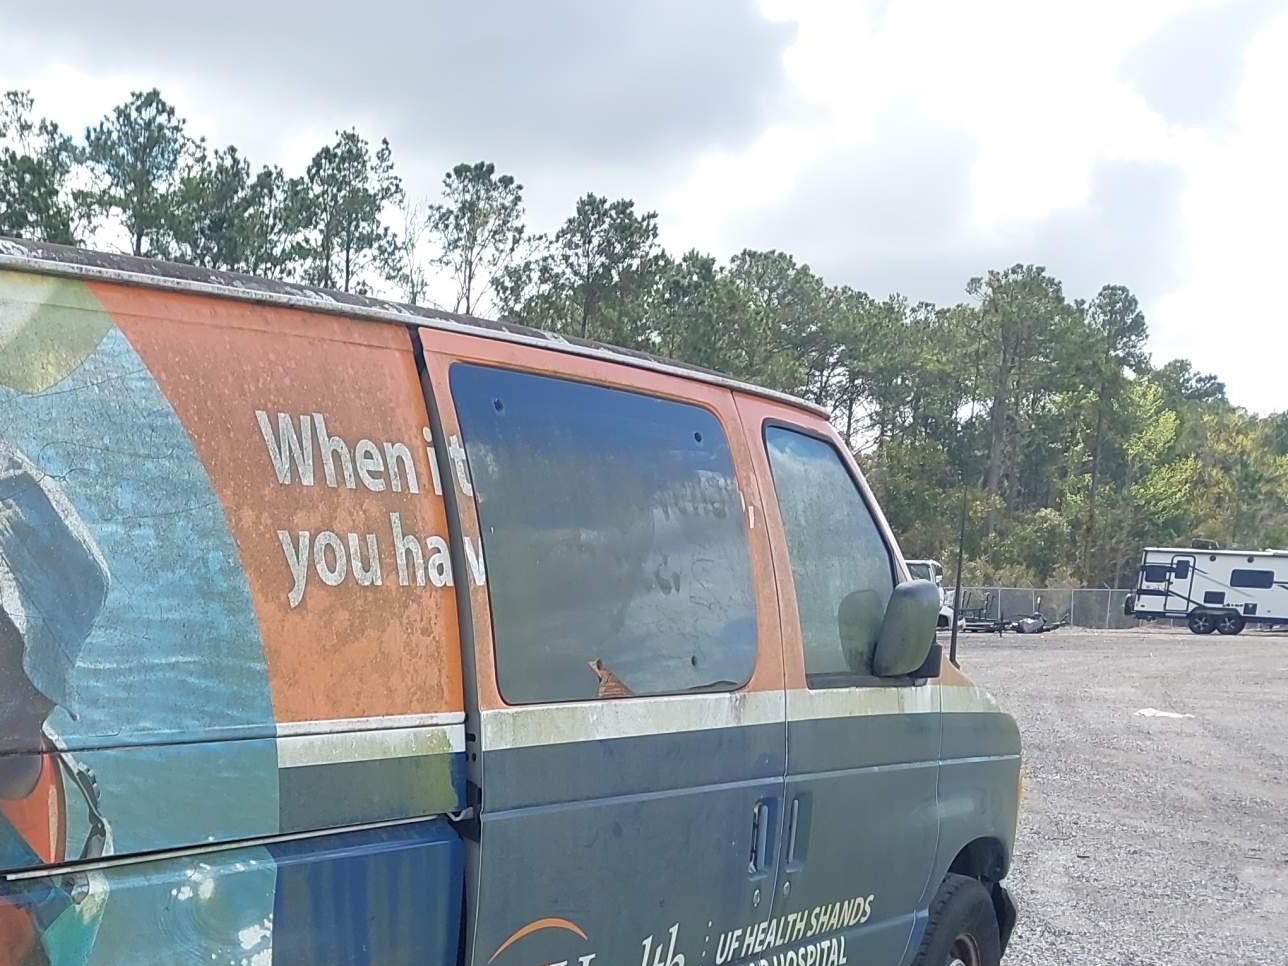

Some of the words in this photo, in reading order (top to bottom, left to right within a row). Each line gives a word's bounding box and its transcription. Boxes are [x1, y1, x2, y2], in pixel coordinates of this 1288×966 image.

[255, 410, 419, 494] When
[277, 529, 383, 608] you
[715, 928, 743, 966] UF
[740, 910, 809, 958] HEALTH
[806, 894, 875, 937] SHANDS
